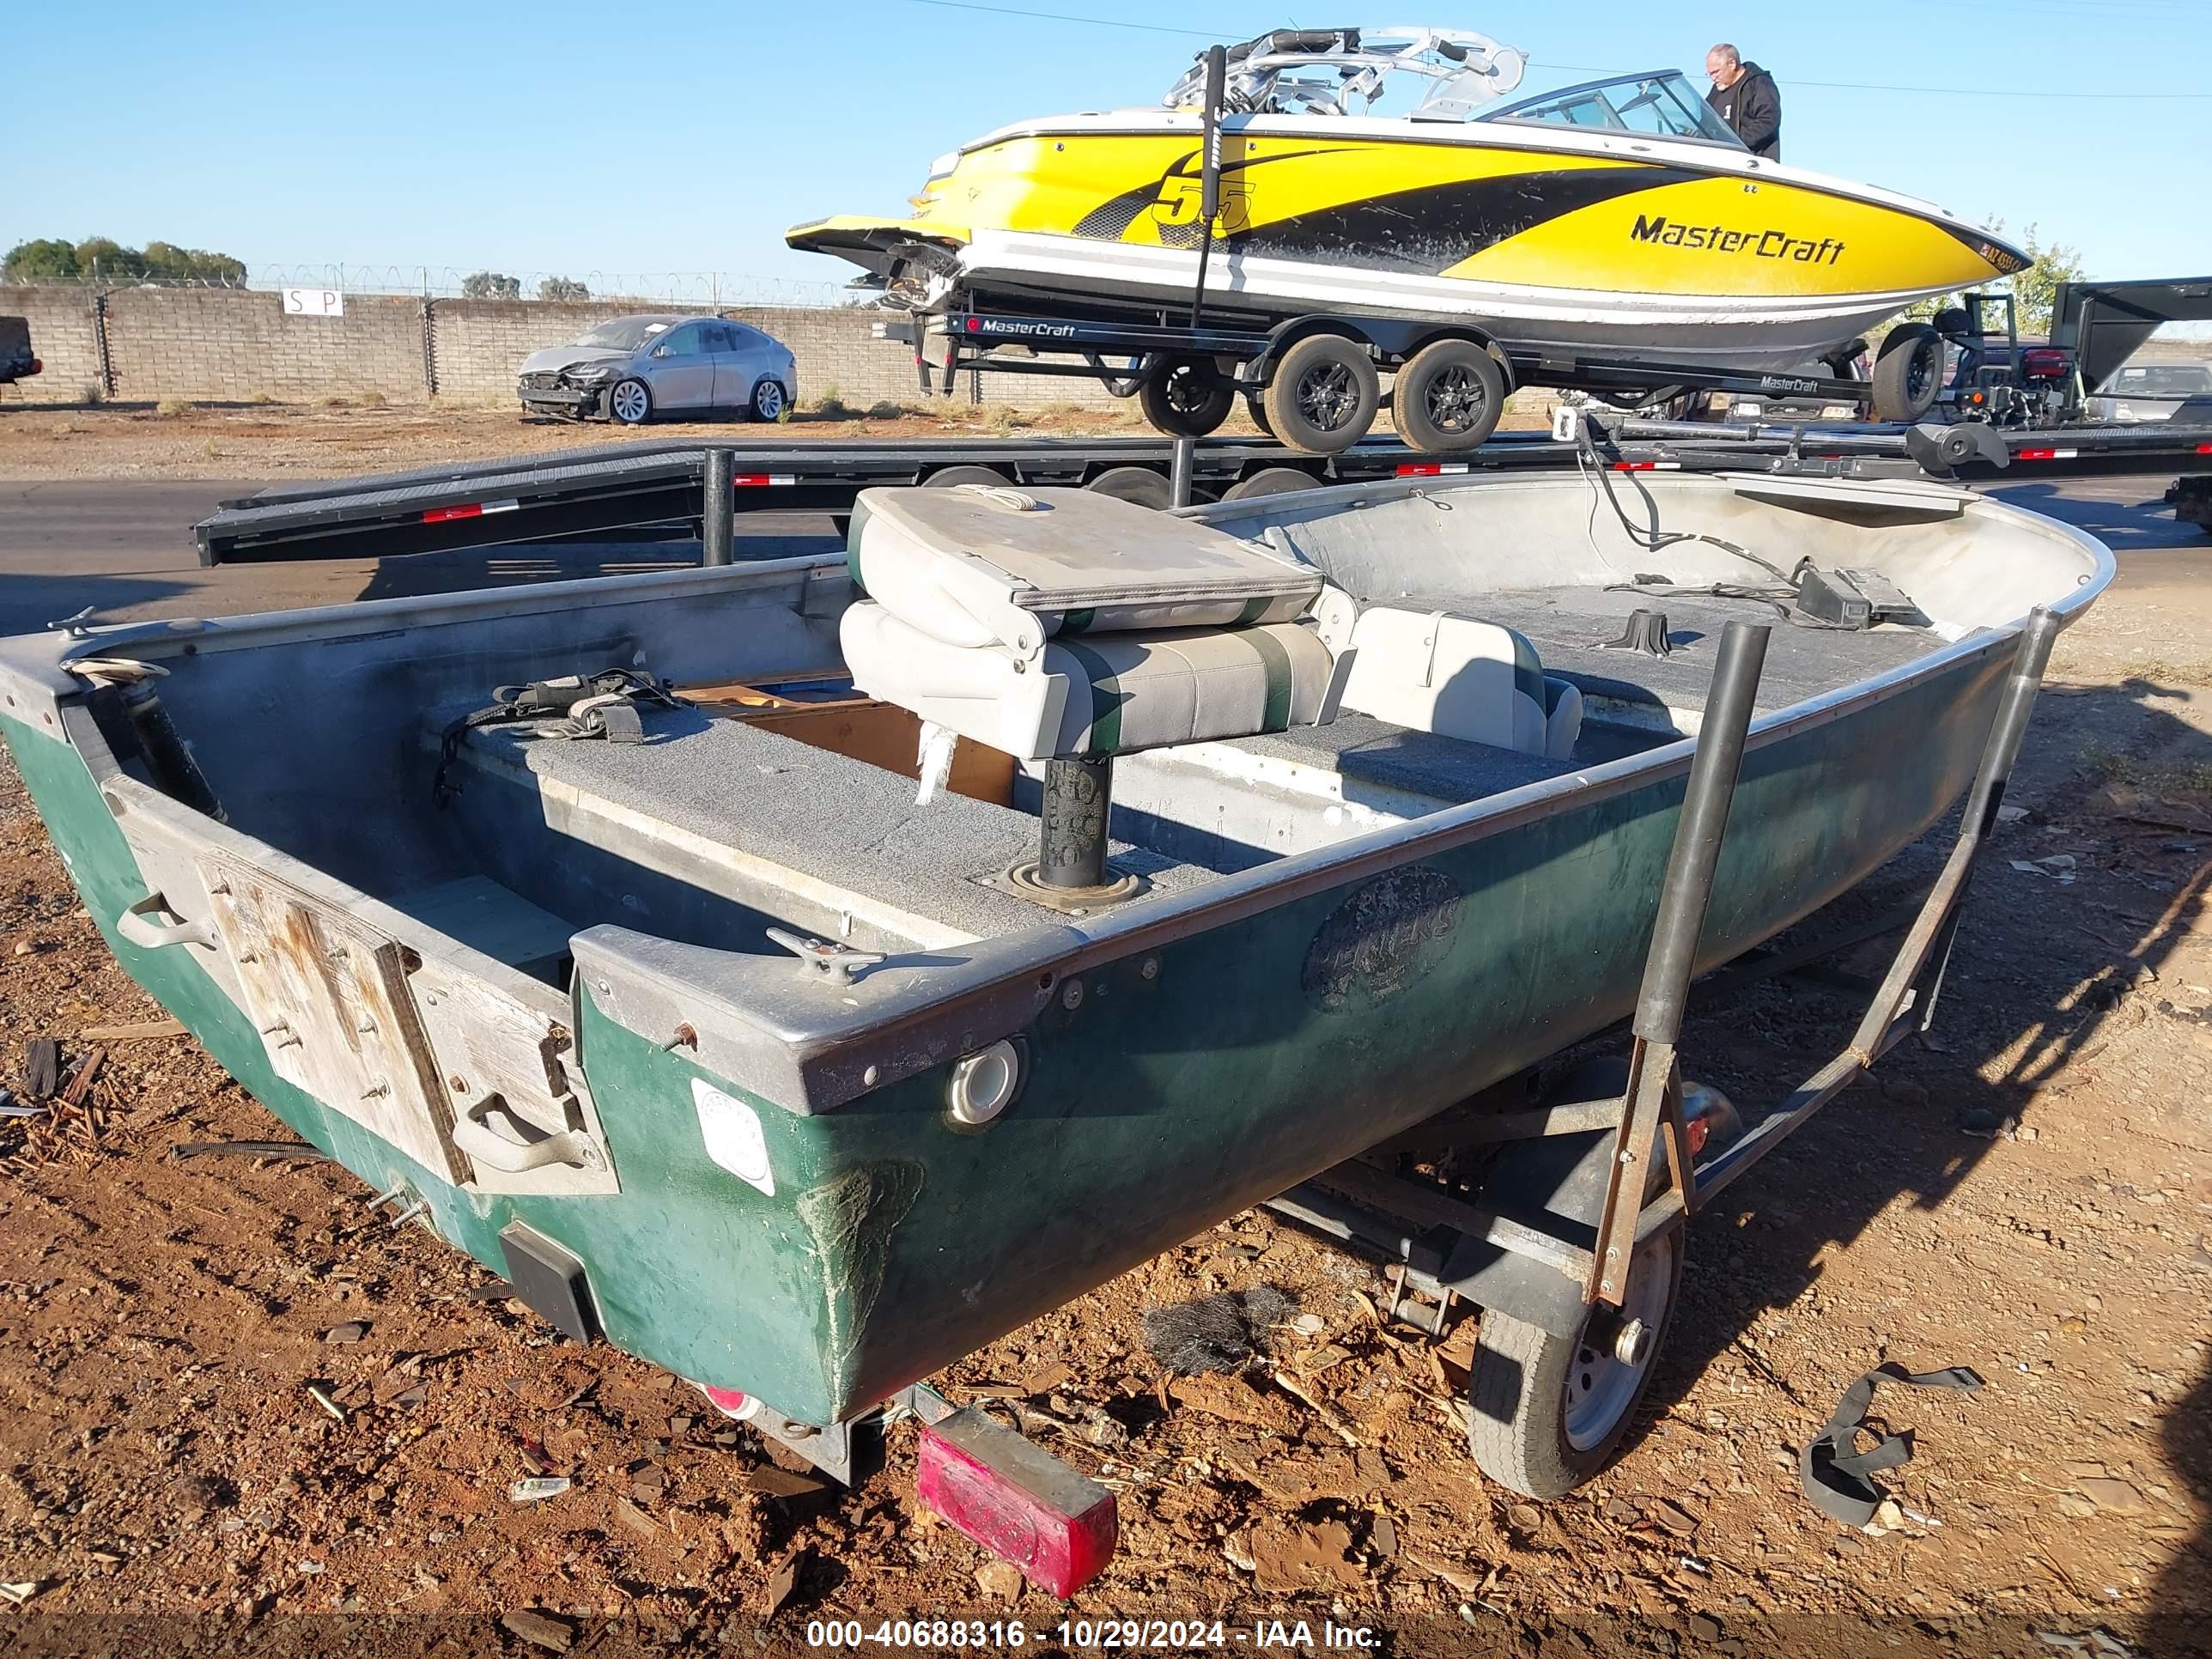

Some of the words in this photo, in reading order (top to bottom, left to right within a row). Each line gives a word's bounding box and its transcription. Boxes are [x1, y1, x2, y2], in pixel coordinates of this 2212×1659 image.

[1152, 174, 1256, 230] 55
[1631, 214, 1845, 265] MasterCraft
[1987, 246, 2000, 263] AZ
[290, 290, 302, 312] S
[323, 292, 336, 313] P
[982, 319, 1075, 337] MasterCraft
[1760, 376, 1818, 392] MasterCraft
